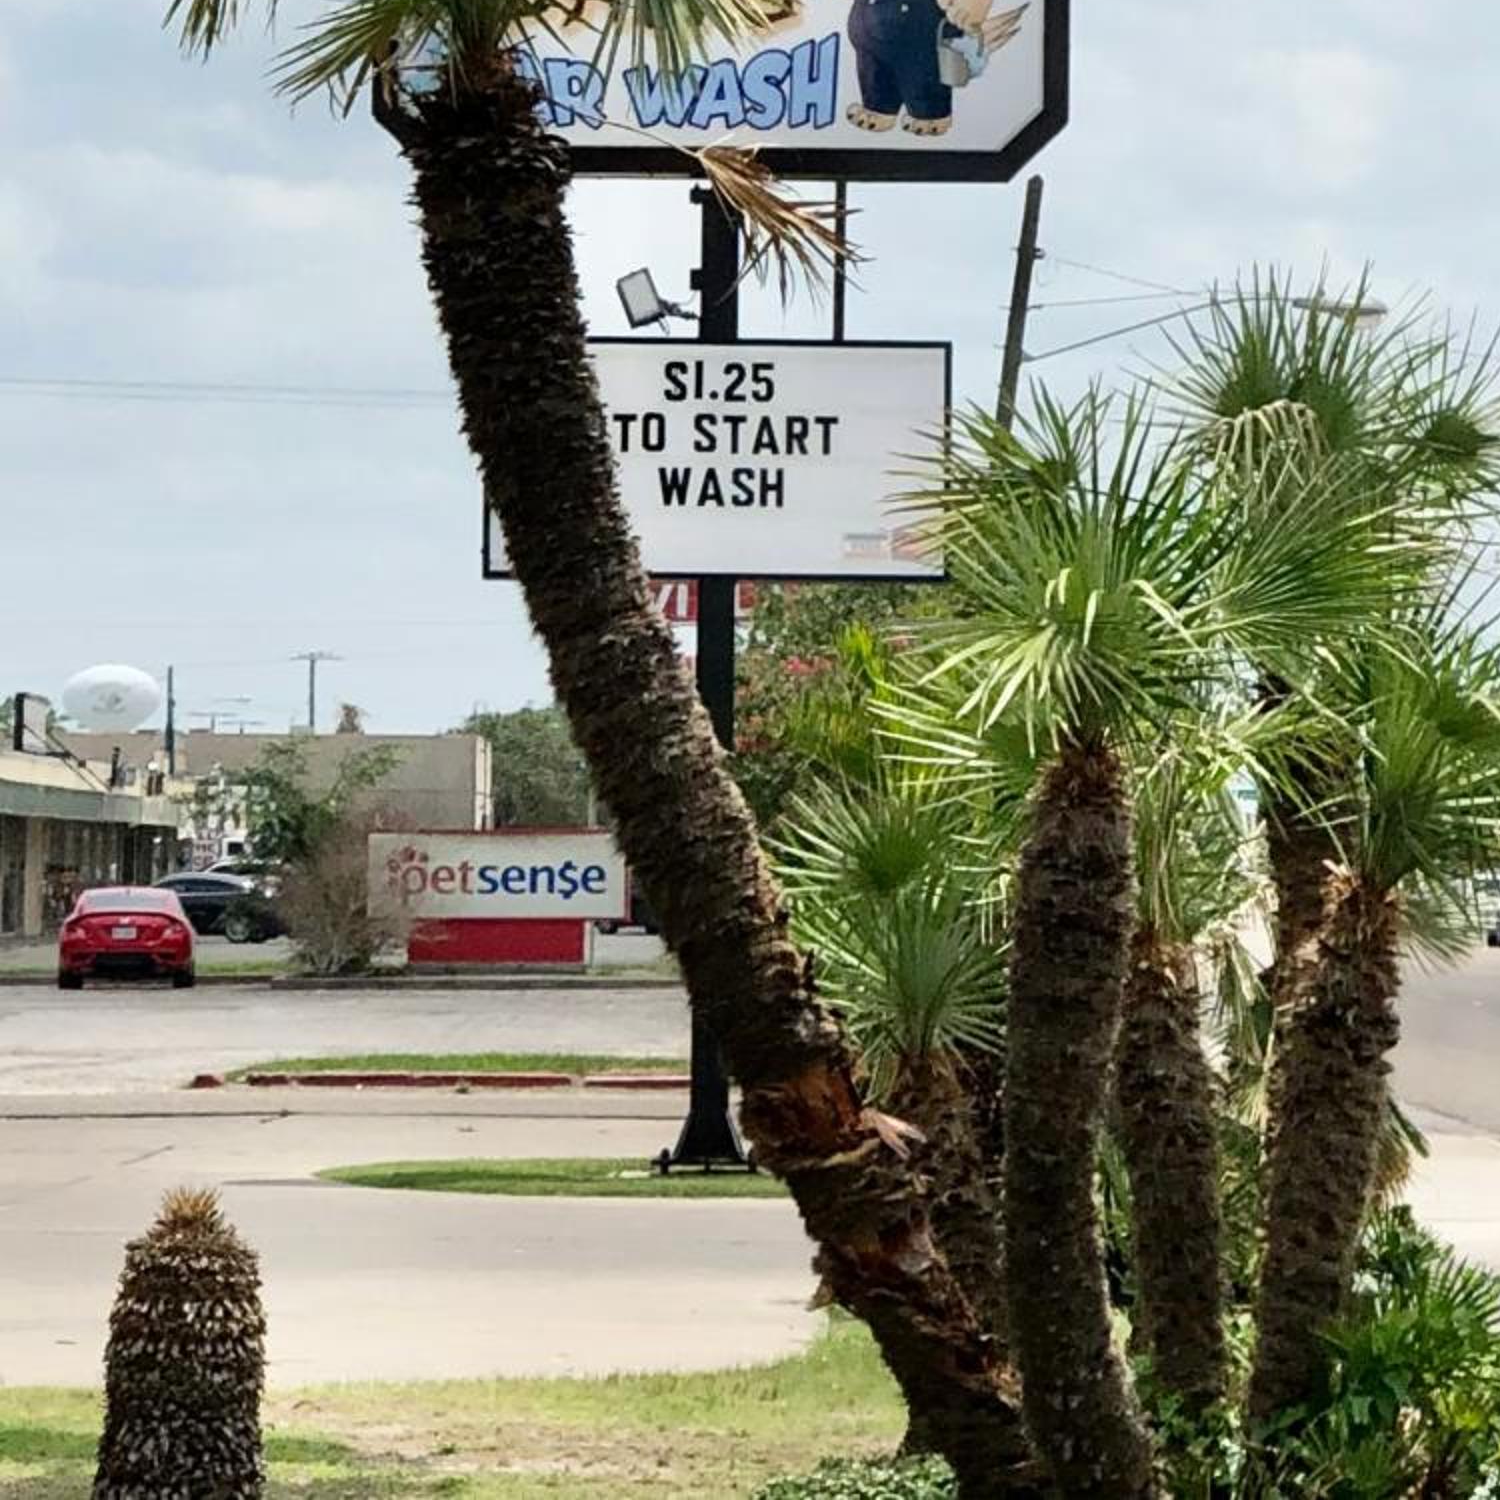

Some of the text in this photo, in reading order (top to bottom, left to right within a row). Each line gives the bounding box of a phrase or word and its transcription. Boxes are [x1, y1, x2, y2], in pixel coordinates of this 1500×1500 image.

[622, 31, 840, 131] WASH
[613, 411, 840, 456] TO START
[657, 466, 785, 508] WASH
